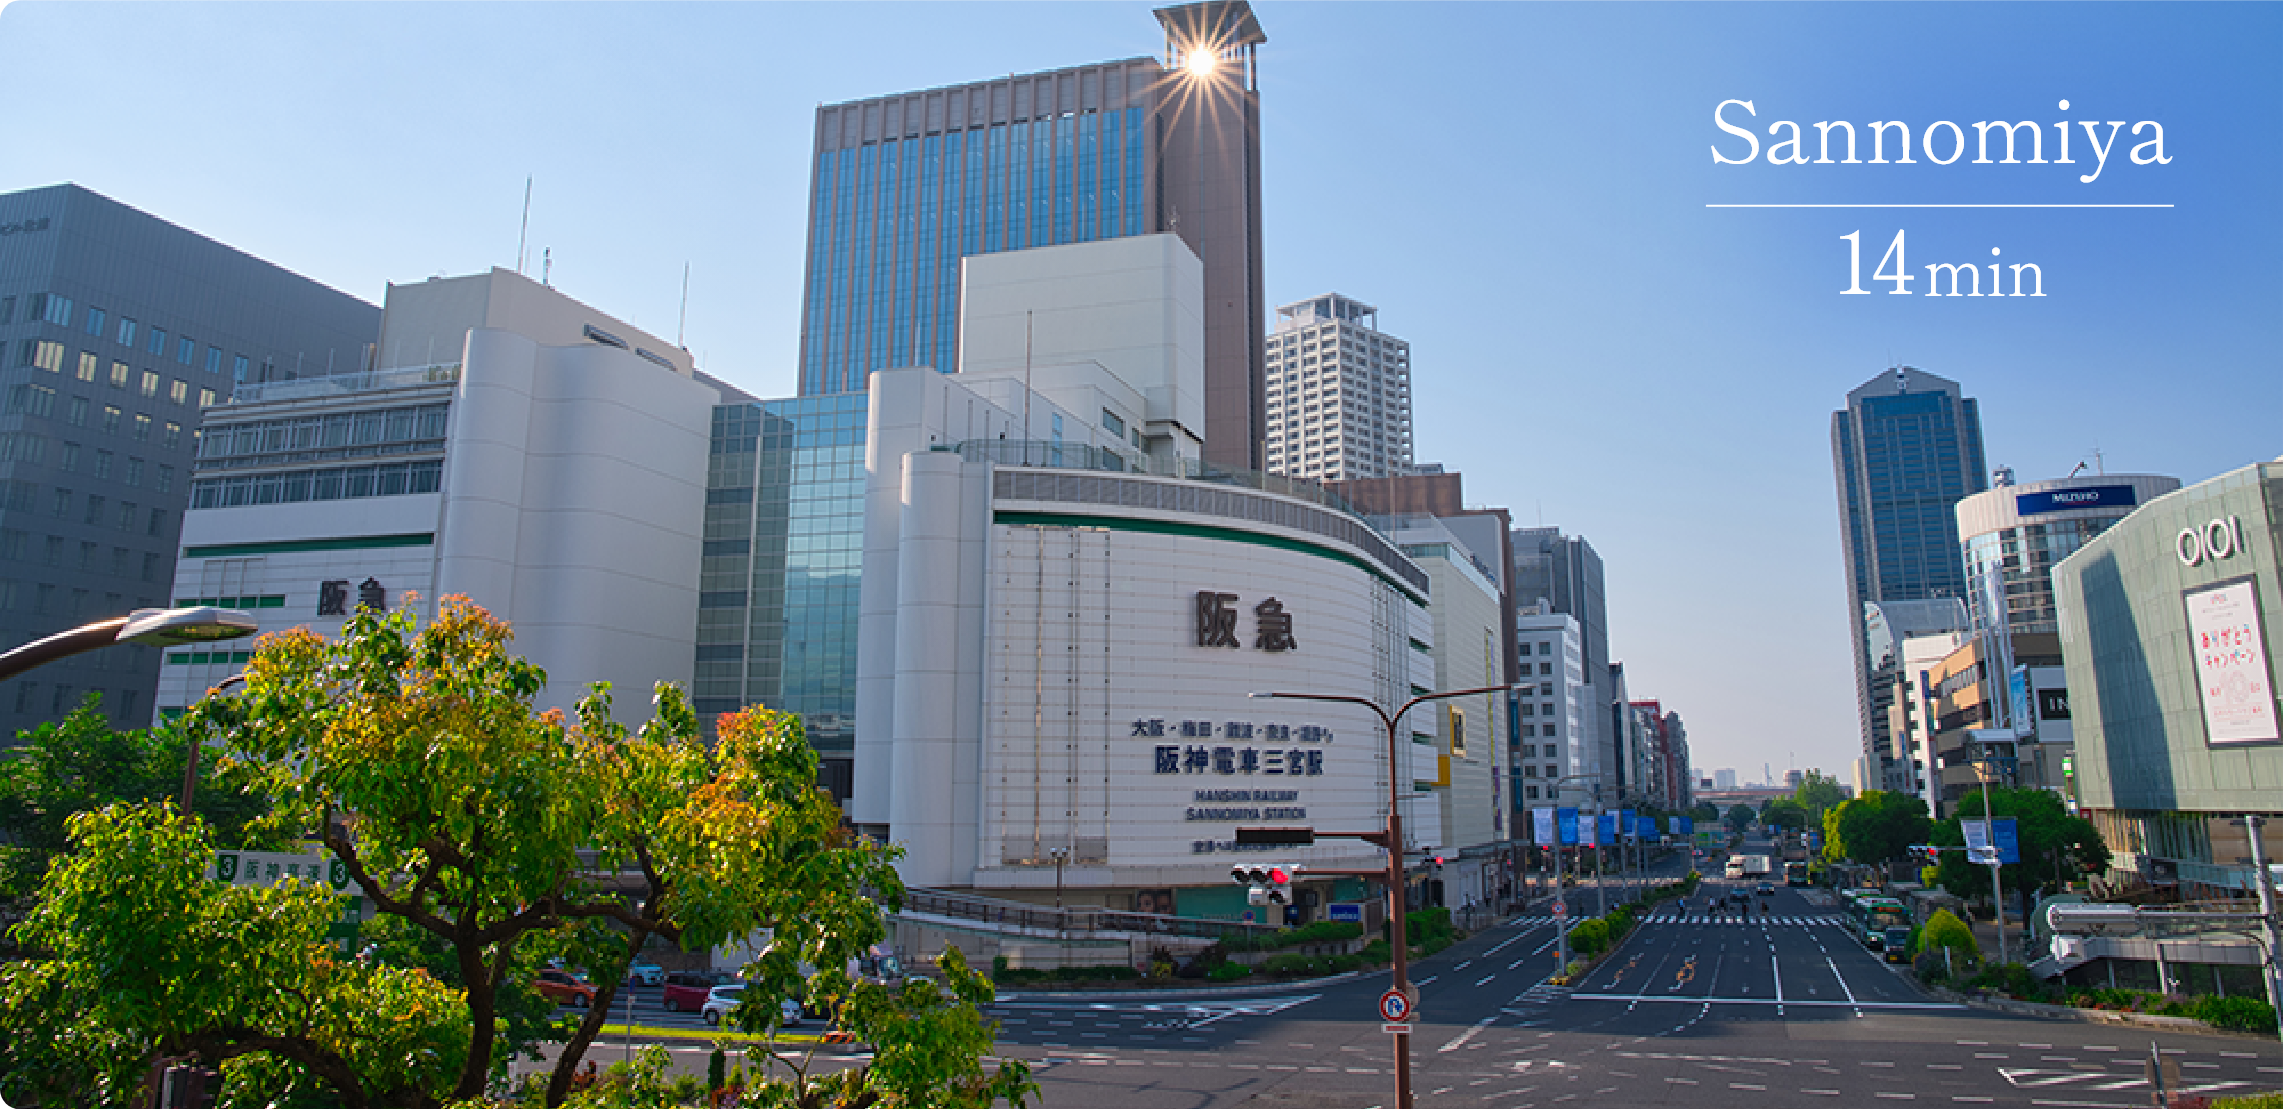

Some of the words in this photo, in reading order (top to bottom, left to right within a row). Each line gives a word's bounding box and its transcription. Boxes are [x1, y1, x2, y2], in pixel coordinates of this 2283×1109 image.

[317, 577, 386, 616] 阪急
[1195, 590, 1298, 652] 阪急
[1154, 744, 1324, 776] 阪神電車三宮駅
[1193, 788, 1251, 803] HANSHIN
[1252, 788, 1300, 803] RAILWAY
[1185, 806, 1261, 821] SANNOMIYA
[1262, 806, 1307, 821] STATION
[221, 857, 234, 876] 3
[333, 863, 346, 883] 3
